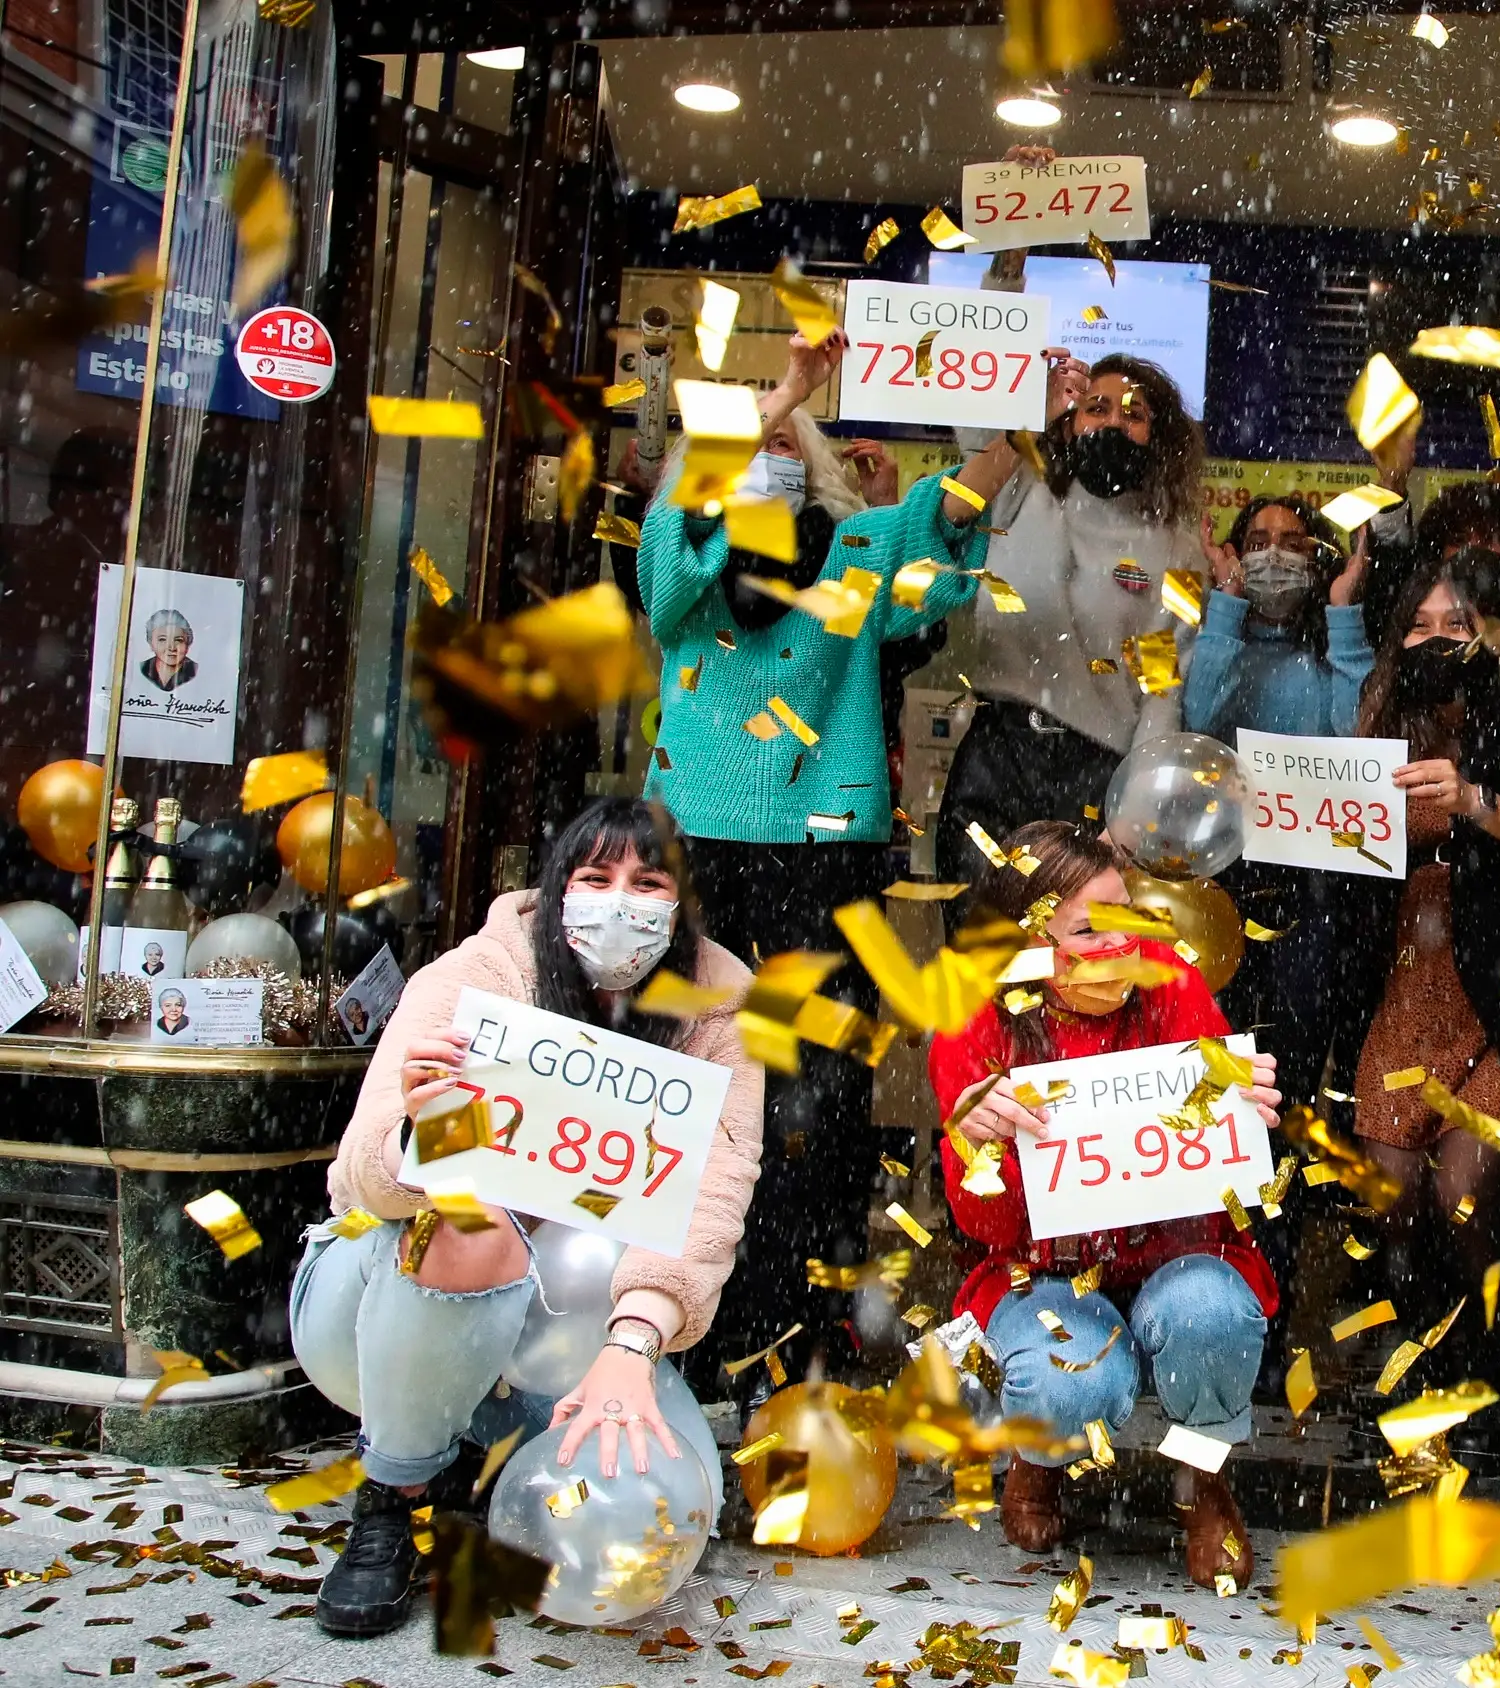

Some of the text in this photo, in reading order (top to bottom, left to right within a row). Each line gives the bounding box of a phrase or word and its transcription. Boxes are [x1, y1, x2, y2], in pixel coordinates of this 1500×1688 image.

[1020, 162, 1122, 180] PREMIO
[974, 183, 1133, 225] 52.472
[866, 297, 1029, 333] EL GORDO
[1116, 321, 1134, 332] tus
[261, 318, 315, 351] +18
[1060, 333, 1106, 346] premios
[856, 342, 1032, 394] 72.897
[1253, 750, 1382, 783] 5º PREMIO
[469, 1017, 694, 1117] EL GORDO
[1090, 1063, 1214, 1109] PREMI
[1034, 1112, 1251, 1193] 75.981
